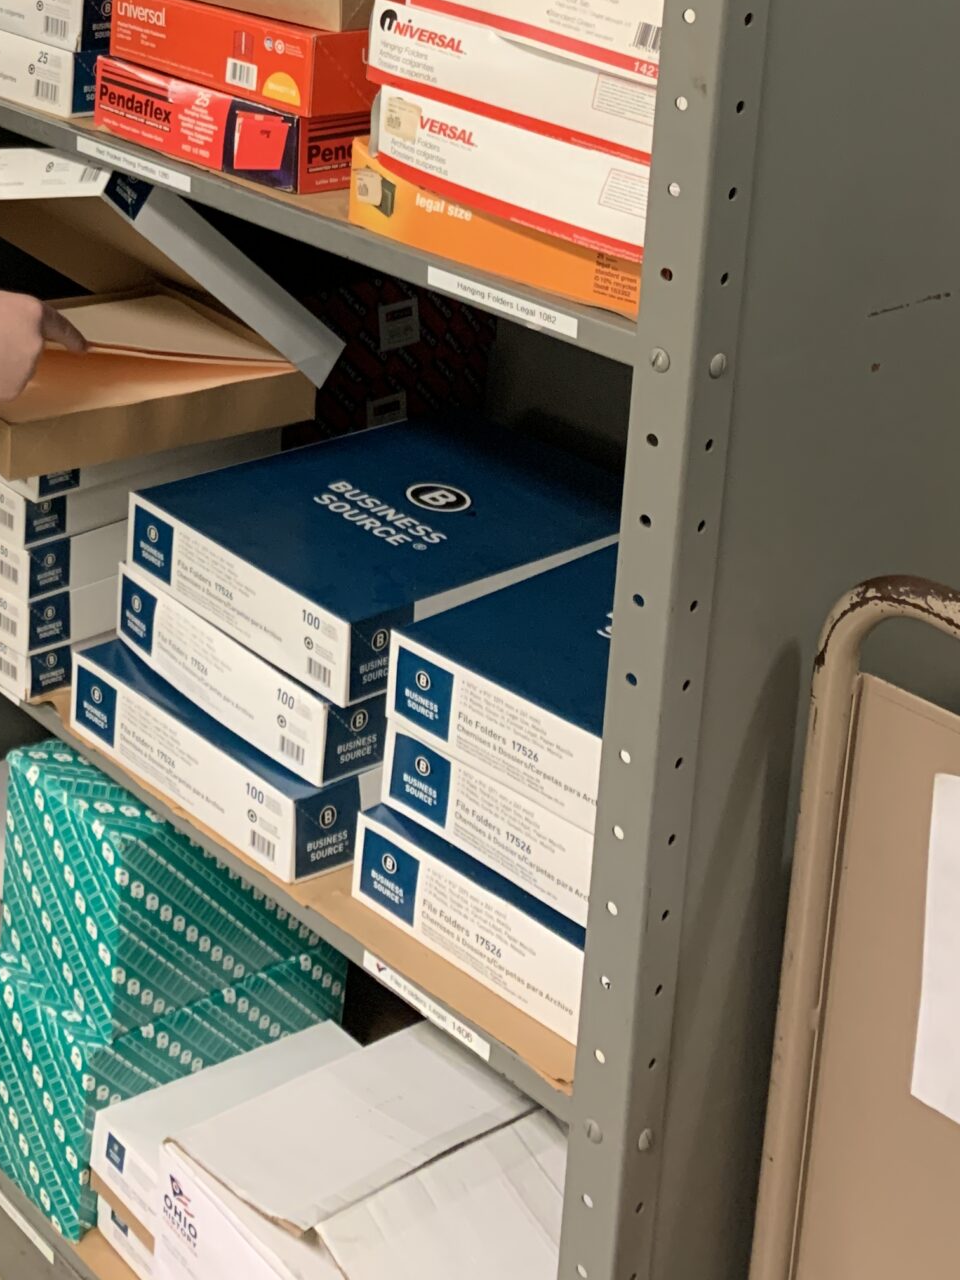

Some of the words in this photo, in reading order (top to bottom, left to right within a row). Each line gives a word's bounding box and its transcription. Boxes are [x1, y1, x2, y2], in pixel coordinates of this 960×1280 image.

[117, 0, 166, 27] universal
[380, 9, 465, 54] UNIVERSAL
[38, 51, 48, 65] 25
[99, 84, 171, 124] Pendaflex
[415, 192, 444, 213] legal
[446, 202, 473, 221] size
[457, 281, 486, 300] Hanging
[487, 291, 514, 311] Folders
[516, 299, 537, 316] Legal
[539, 310, 557, 324] 1082
[313, 493, 412, 547] SOURCE
[328, 480, 448, 545] BUSINESS
[0, 545, 9, 557] 50
[140, 540, 165, 560] BUSINESS
[141, 552, 162, 567] SOURCE
[177, 558, 193, 574] File
[189, 563, 212, 587] Folders
[214, 580, 234, 602] 17526
[0, 598, 7, 610] 50
[301, 607, 321, 632] 100
[190, 656, 209, 676] 17526
[359, 657, 389, 675] BUSINE
[362, 670, 388, 685] SOURC
[276, 687, 295, 710] 100
[405, 688, 439, 713] BUSINESS
[407, 699, 435, 720] SOURCE
[83, 700, 108, 722] BUSINESS
[85, 708, 105, 729] SOURCE
[130, 728, 154, 753] Folders
[156, 748, 176, 769] 17526
[337, 734, 377, 755] BUSINESS
[457, 712, 473, 727] File
[474, 719, 507, 746] Folders
[511, 740, 539, 763] 17526
[340, 746, 372, 764] SOURCE
[245, 782, 264, 805] 100
[403, 774, 437, 798] BUSINESS
[405, 785, 433, 806] SOURCE
[457, 800, 469, 812] File
[471, 807, 501, 834] Folders
[505, 831, 532, 854] 17526
[307, 830, 348, 852] BUSINESS
[310, 843, 344, 862] SOURCE
[371, 870, 404, 897] BUSINESS
[373, 882, 400, 904] SOURCE
[422, 898, 437, 913] File
[439, 905, 470, 938] Folders
[475, 933, 502, 959] 17526
[422, 911, 455, 938] Chemises
[544, 994, 574, 1016] Archivo
[163, 1206, 196, 1248] HISTORY
[164, 1194, 197, 1239] OHIO
